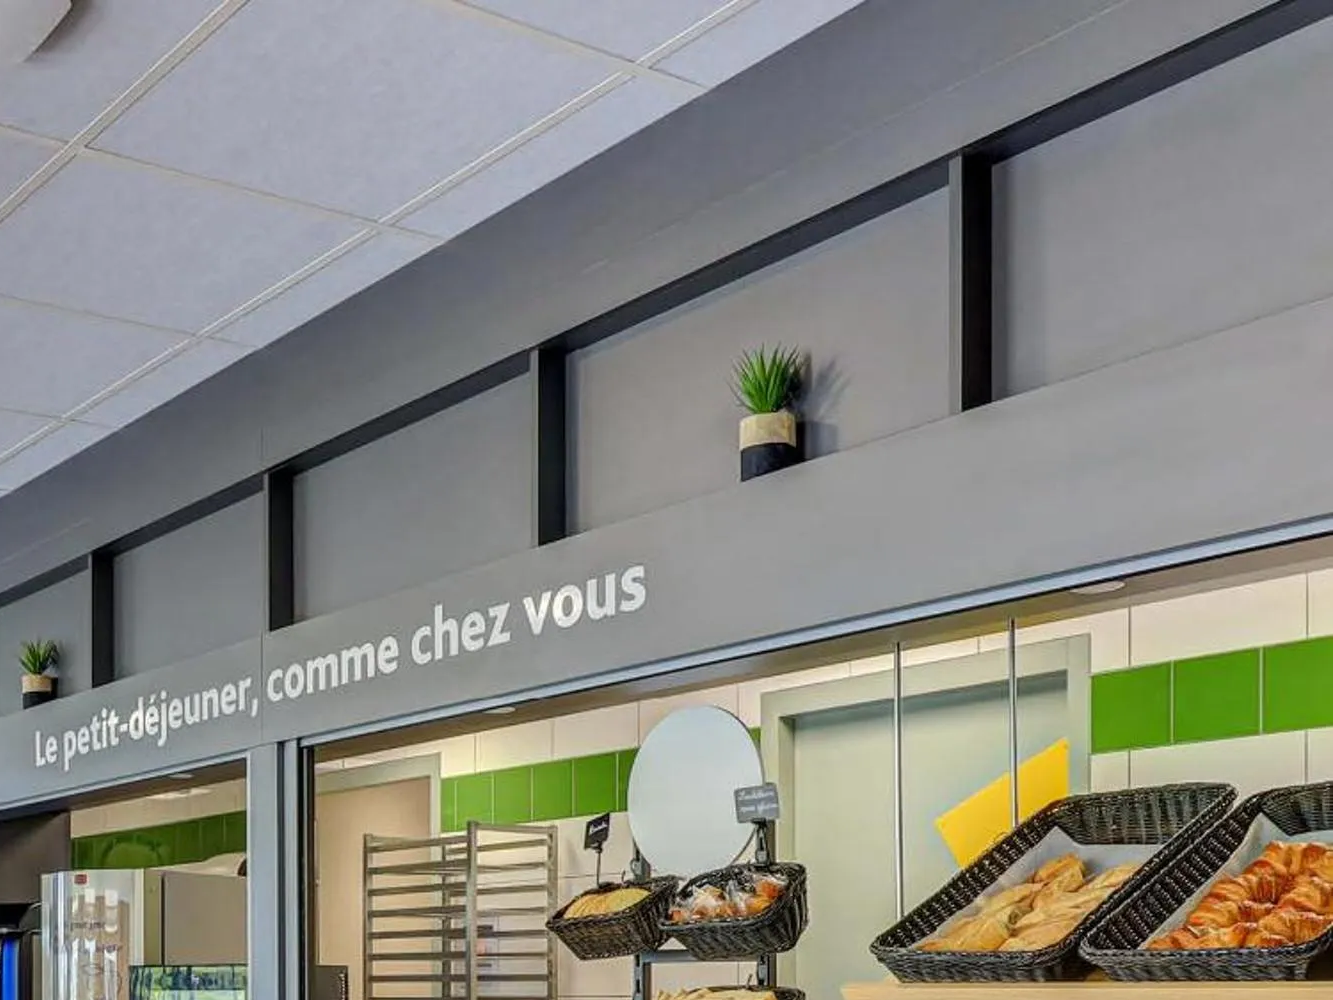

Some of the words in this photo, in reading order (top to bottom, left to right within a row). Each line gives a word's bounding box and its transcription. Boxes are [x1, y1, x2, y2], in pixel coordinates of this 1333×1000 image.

[34, 730, 58, 767] Le
[62, 675, 259, 772] petit-déjeuner,
[266, 634, 400, 702] comme
[410, 600, 512, 666] chez
[522, 564, 647, 635] vous
